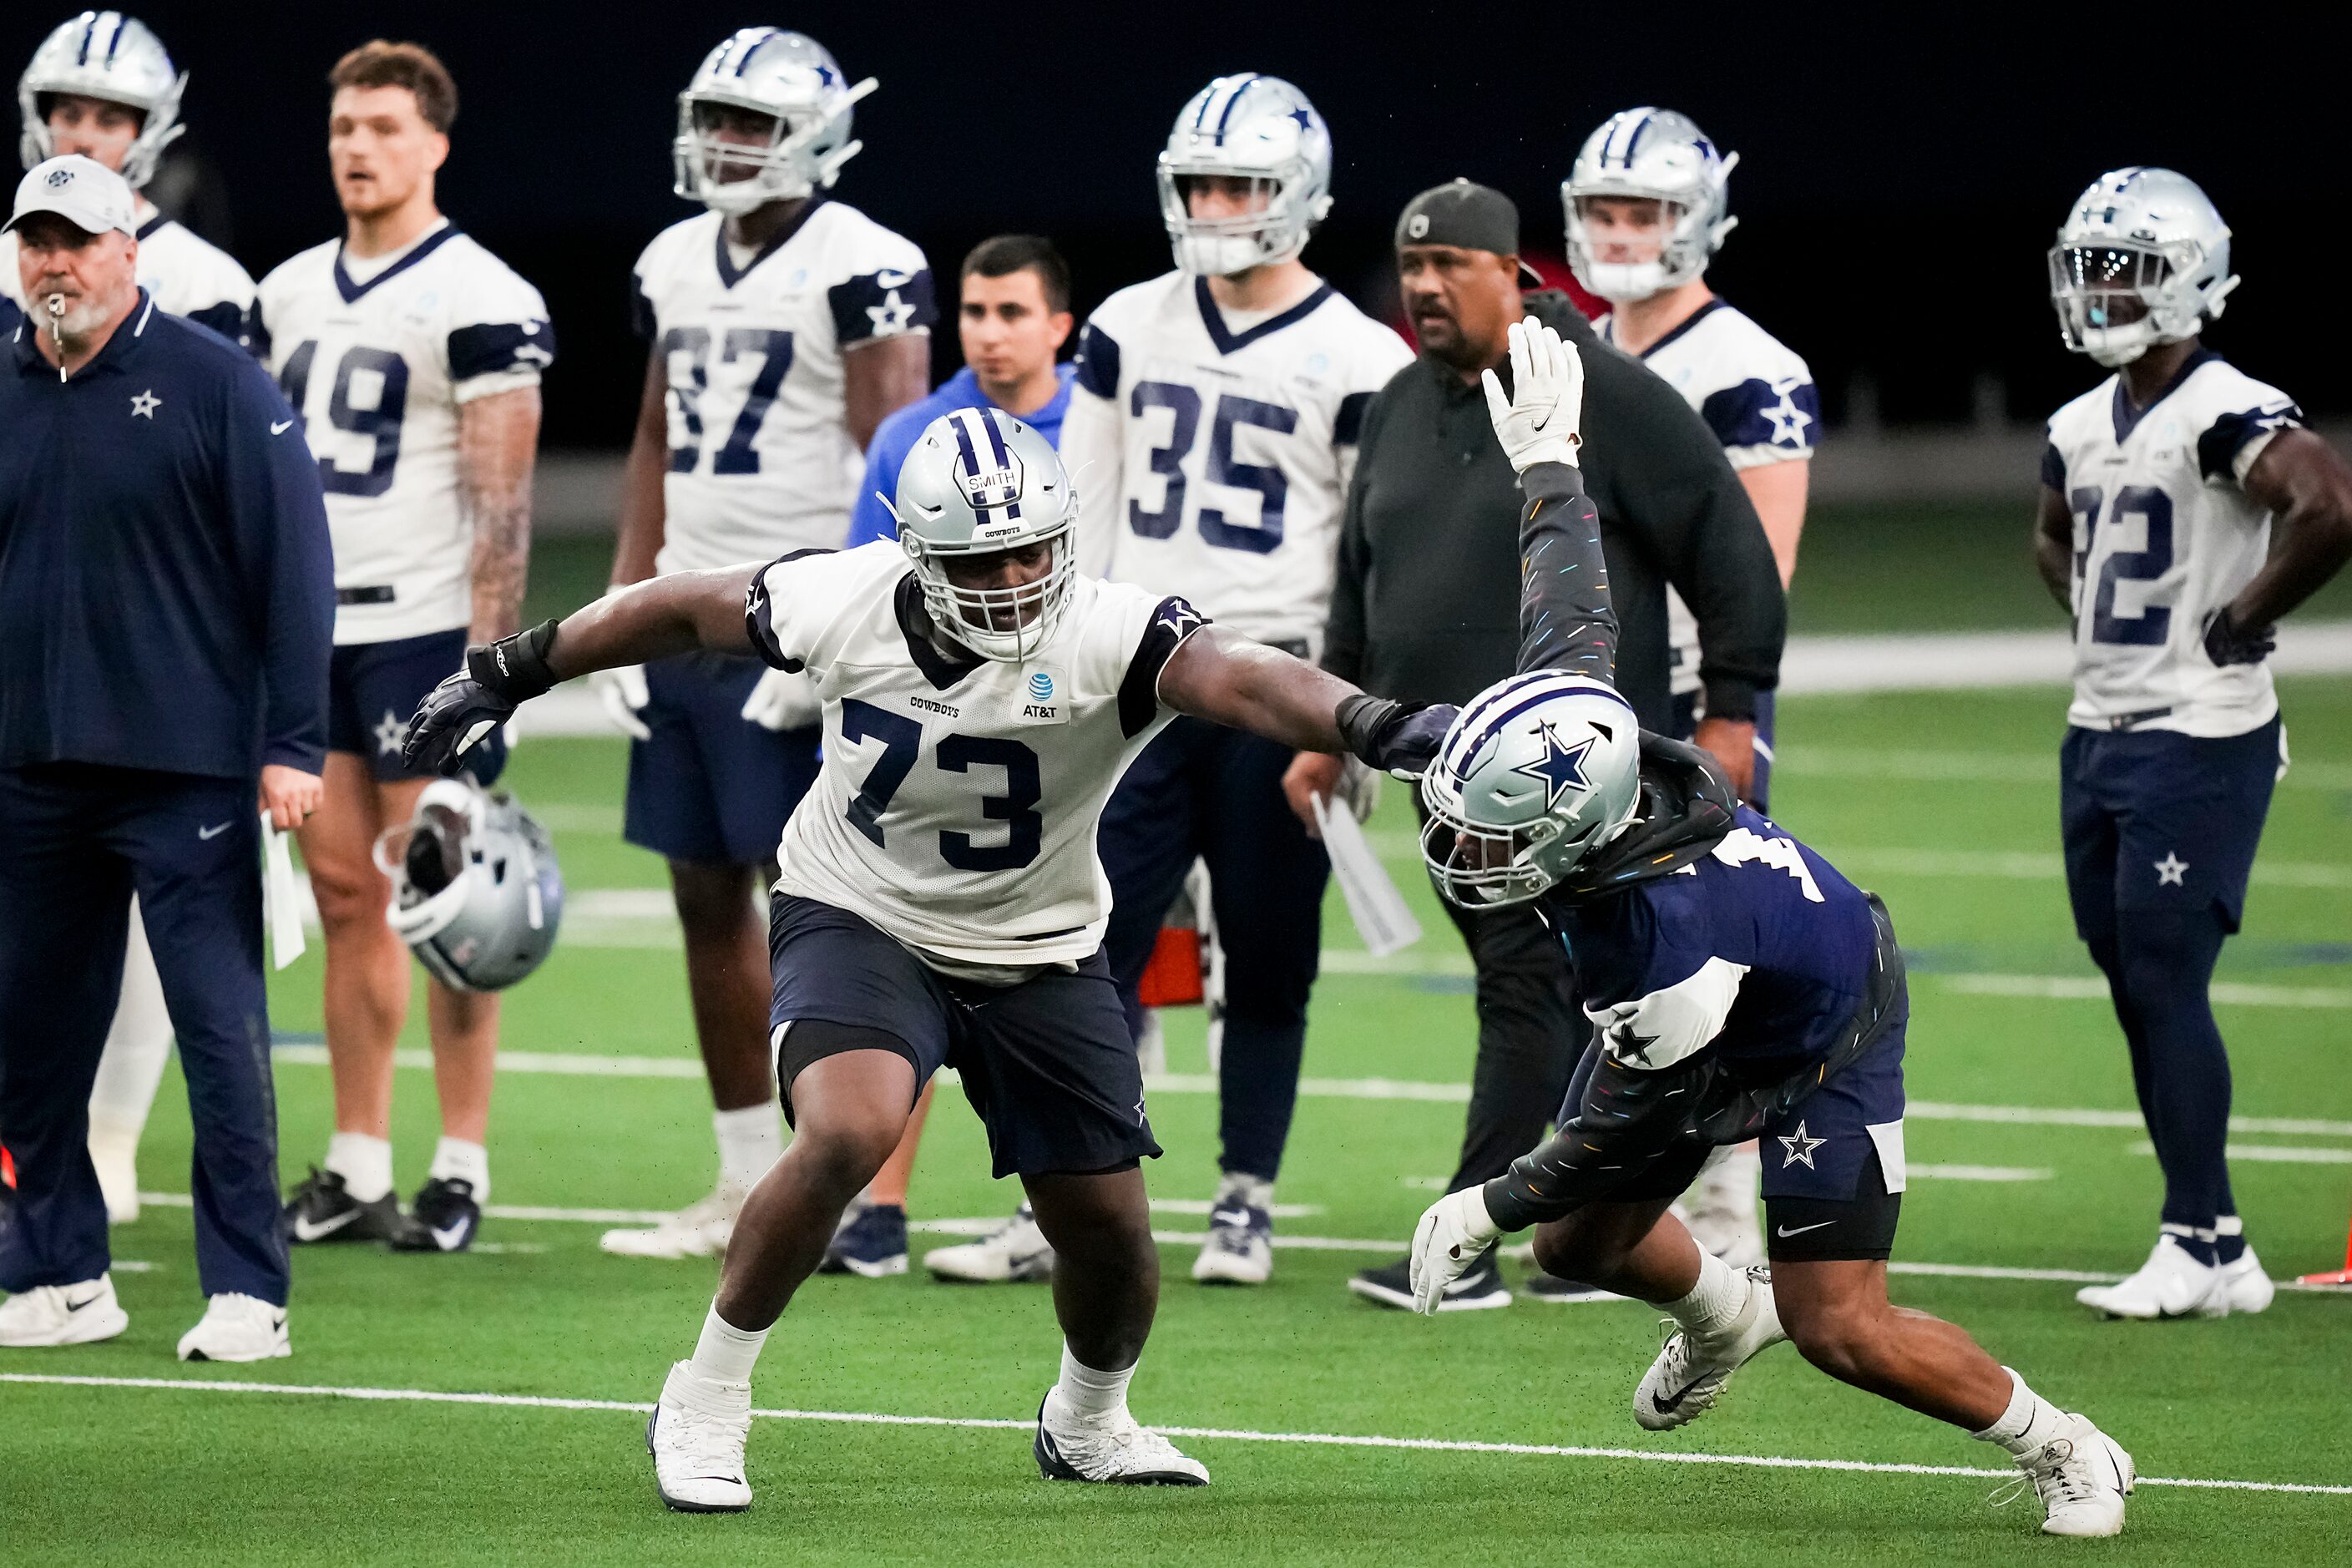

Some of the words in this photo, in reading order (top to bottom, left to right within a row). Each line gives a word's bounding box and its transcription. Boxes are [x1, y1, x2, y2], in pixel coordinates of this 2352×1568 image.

[1130, 381, 1299, 554] 35
[969, 472, 1016, 491] SMITH
[985, 526, 1020, 538] COWBOYS
[910, 696, 959, 719] COWBOYS
[1023, 705, 1057, 718] AT&T
[841, 697, 1043, 872] 73
